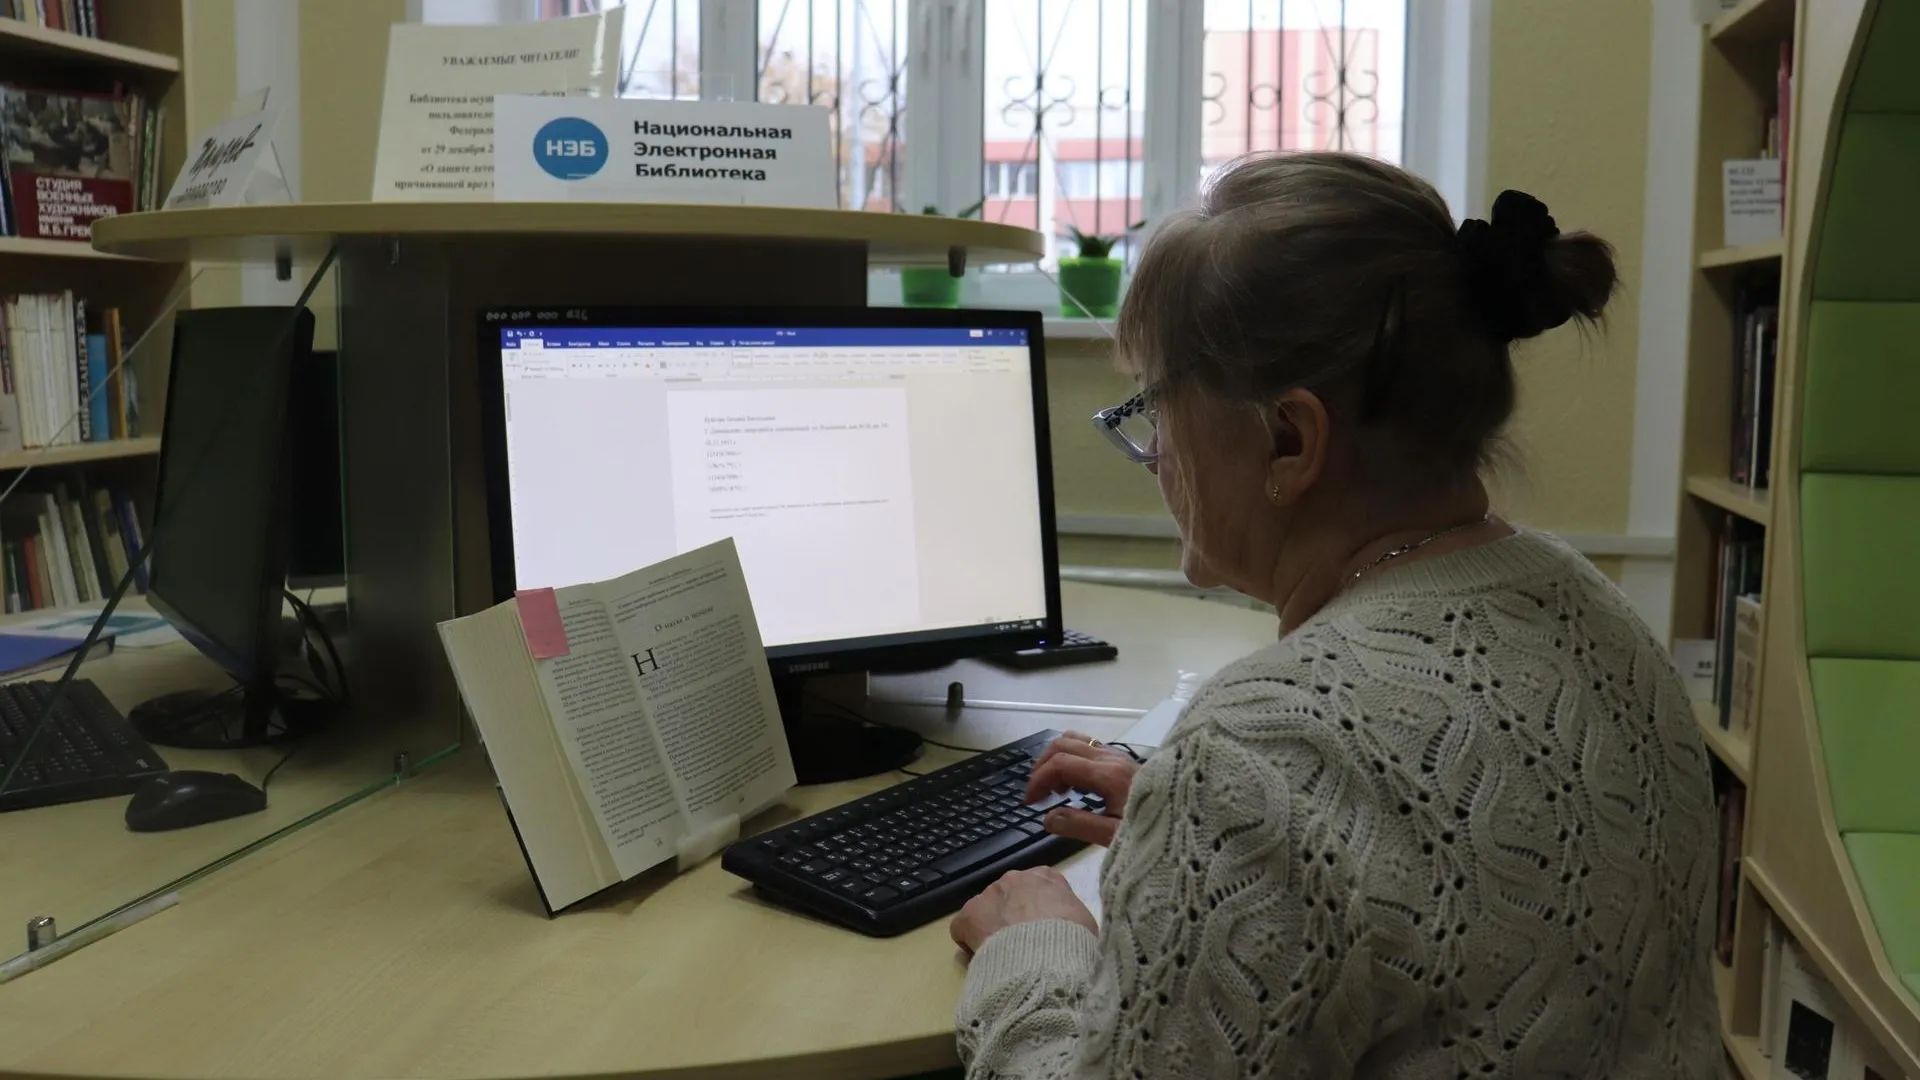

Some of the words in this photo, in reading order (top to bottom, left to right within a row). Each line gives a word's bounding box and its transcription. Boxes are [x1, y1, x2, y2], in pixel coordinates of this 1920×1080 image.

[442, 53, 516, 67] УВАЖАЕМЫЕ
[409, 93, 468, 105] Библиотека
[428, 111, 494, 121] пользователе
[449, 126, 494, 138] Федераль
[633, 120, 792, 140] Национальная
[545, 139, 597, 158] НЭБ
[633, 141, 777, 161] Электронная
[635, 162, 767, 182] Библиотека
[36, 177, 82, 192] СТУДИЯ
[36, 190, 94, 204] ВОЕННЫХ
[38, 203, 118, 218] ХУДОЖНИКОВ
